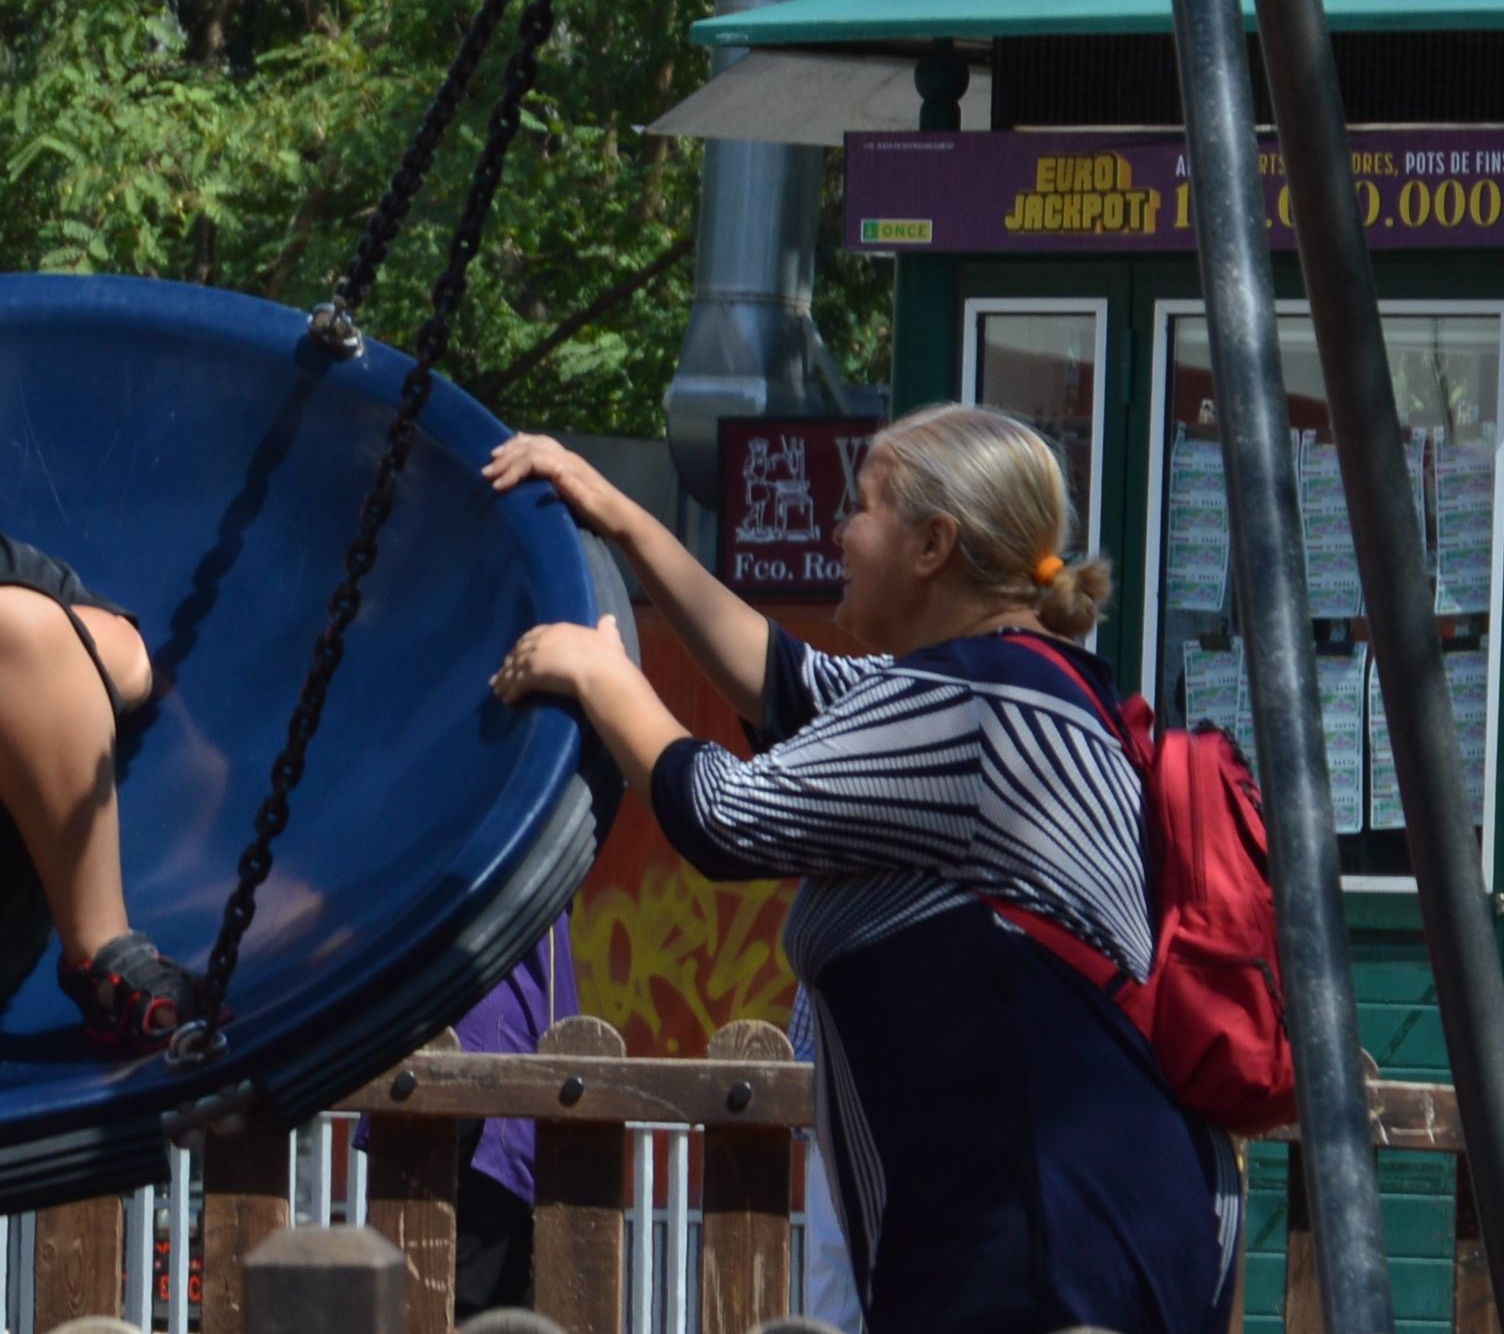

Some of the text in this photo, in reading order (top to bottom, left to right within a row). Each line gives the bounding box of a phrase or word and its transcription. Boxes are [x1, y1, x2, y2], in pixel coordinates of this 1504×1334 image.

[1036, 153, 1121, 192] EURO
[1405, 151, 1445, 175] POTS
[1450, 151, 1470, 174] DE
[1004, 191, 1150, 233] JACKPOT
[882, 223, 927, 238] ONCE
[733, 552, 848, 581] Fco. Ro
